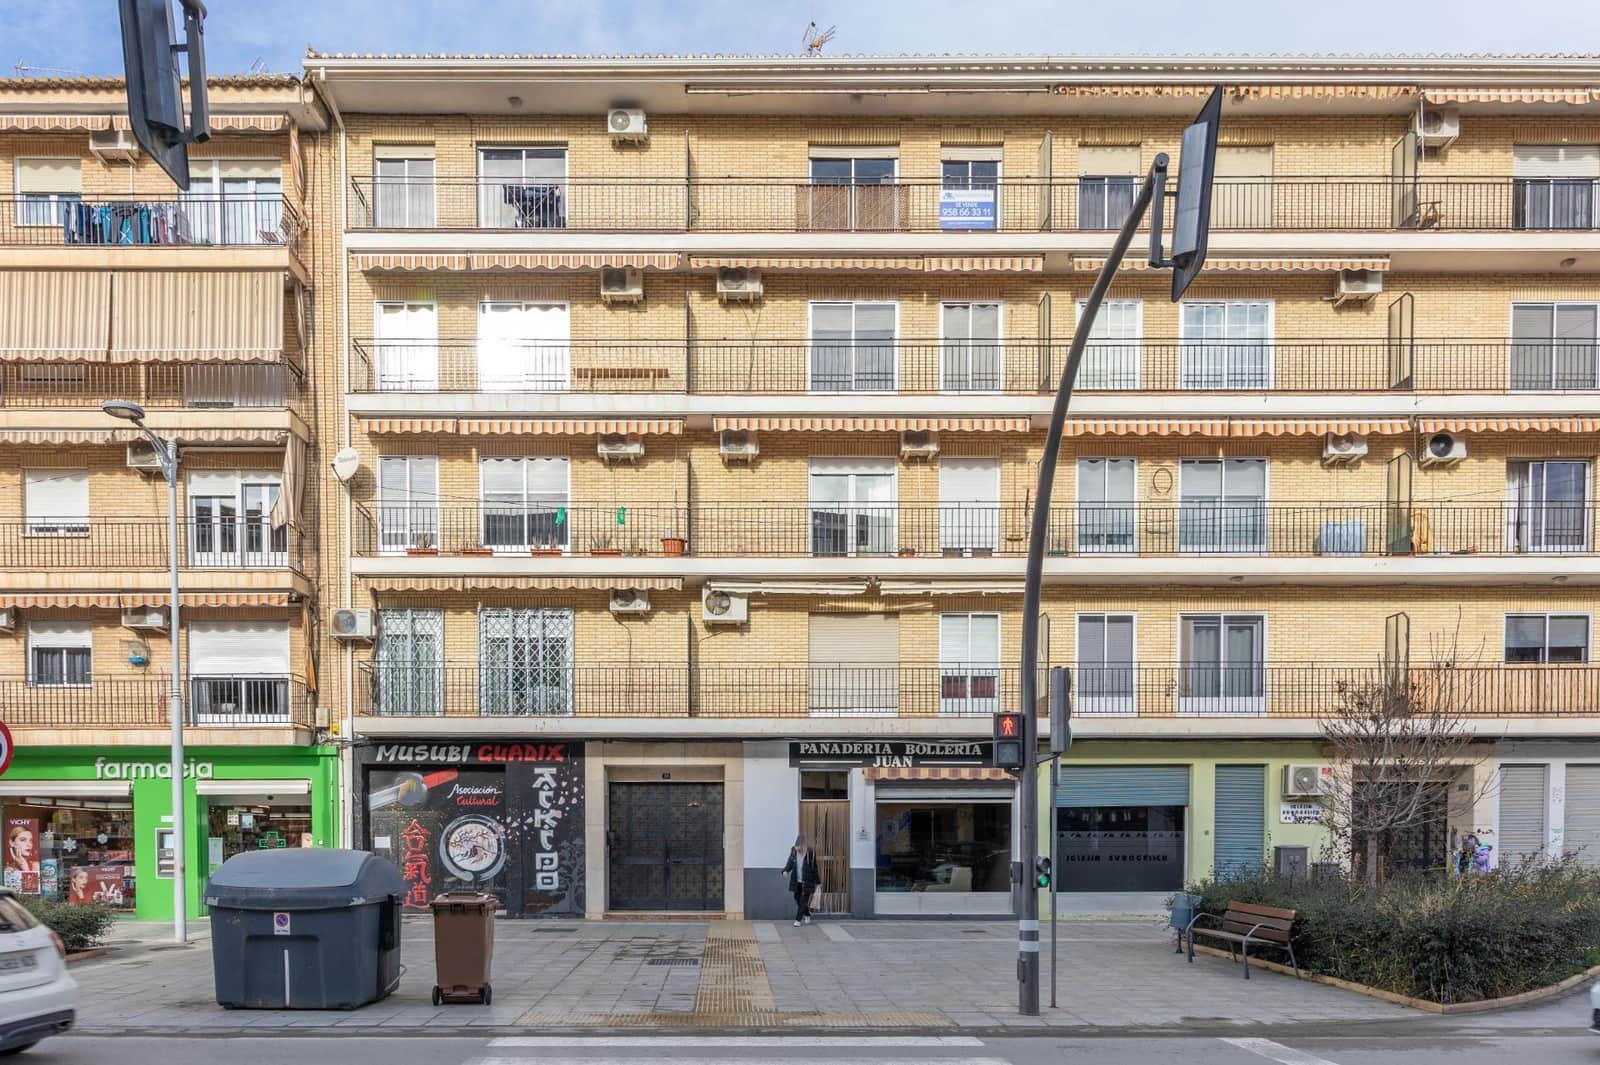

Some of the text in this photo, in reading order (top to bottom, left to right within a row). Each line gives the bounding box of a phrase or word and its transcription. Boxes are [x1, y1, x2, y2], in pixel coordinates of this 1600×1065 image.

[943, 208, 991, 216] 958 66 33 11
[376, 744, 565, 762] MUSUBI GUADIX
[800, 742, 982, 755] PANADERIA BOLLERIA
[872, 755, 913, 768] JUAN
[446, 783, 502, 799] Asociación
[456, 796, 499, 806] Cultural
